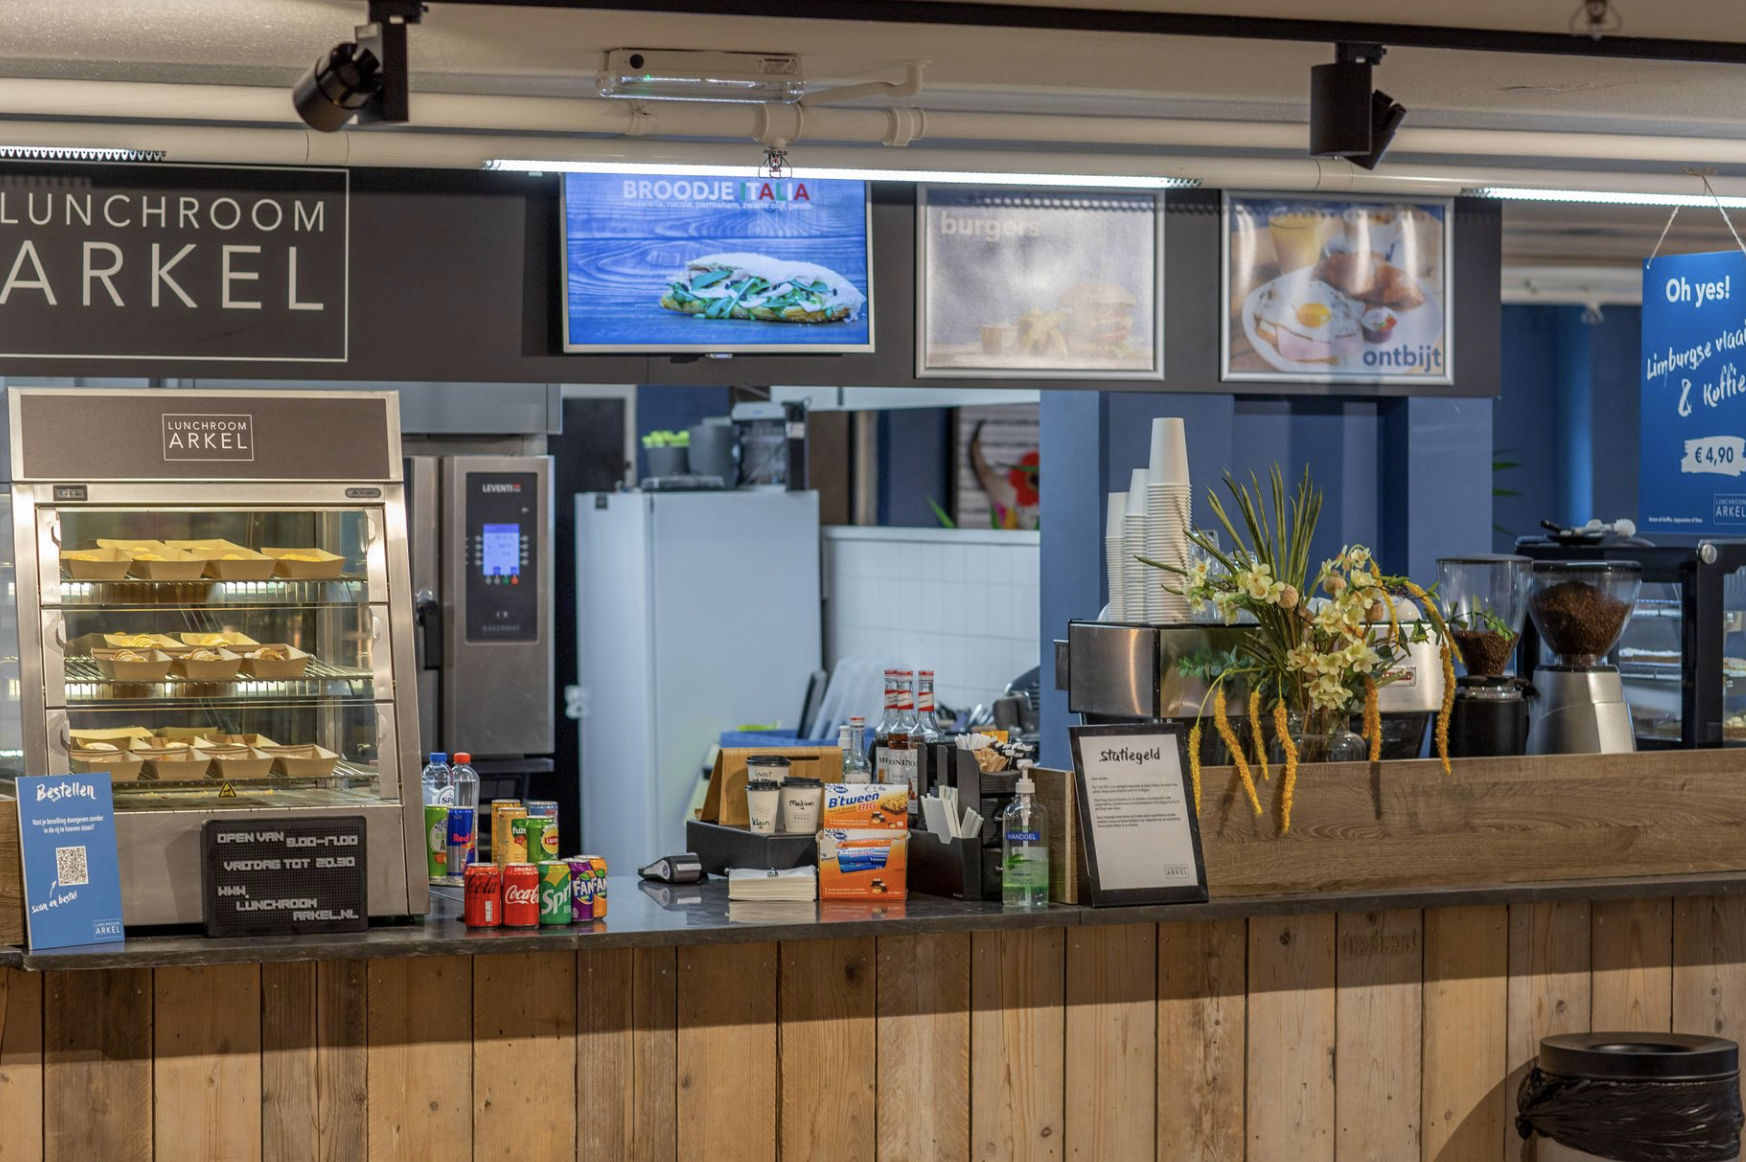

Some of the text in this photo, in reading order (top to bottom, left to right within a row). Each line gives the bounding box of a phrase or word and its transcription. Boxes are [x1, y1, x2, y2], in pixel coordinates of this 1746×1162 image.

[623, 180, 810, 201] BROODJE ITALIA
[0, 192, 324, 232] LUNCHROOM
[941, 211, 1041, 242] burgers
[0, 240, 324, 310] ARKEL
[1666, 275, 1730, 308] Oh yes!
[1363, 345, 1442, 373] ontbijt
[1646, 341, 1712, 381] Limburgse
[1678, 379, 1692, 417] &
[168, 421, 247, 431] LUNCHROOM
[168, 432, 248, 450] ARKEL
[1695, 446, 1734, 466] € 4,90
[1716, 506, 1746, 518] ARKEL
[36, 781, 97, 802] Bestellen
[828, 793, 880, 809] B'tween
[857, 802, 876, 812] BIG
[217, 833, 254, 844] OPEN
[256, 832, 284, 842] VAN
[283, 858, 310, 870] TOT
[316, 857, 355, 868] 20.30
[236, 898, 318, 912] LUNCHROOM
[95, 927, 120, 935] ARKEL
